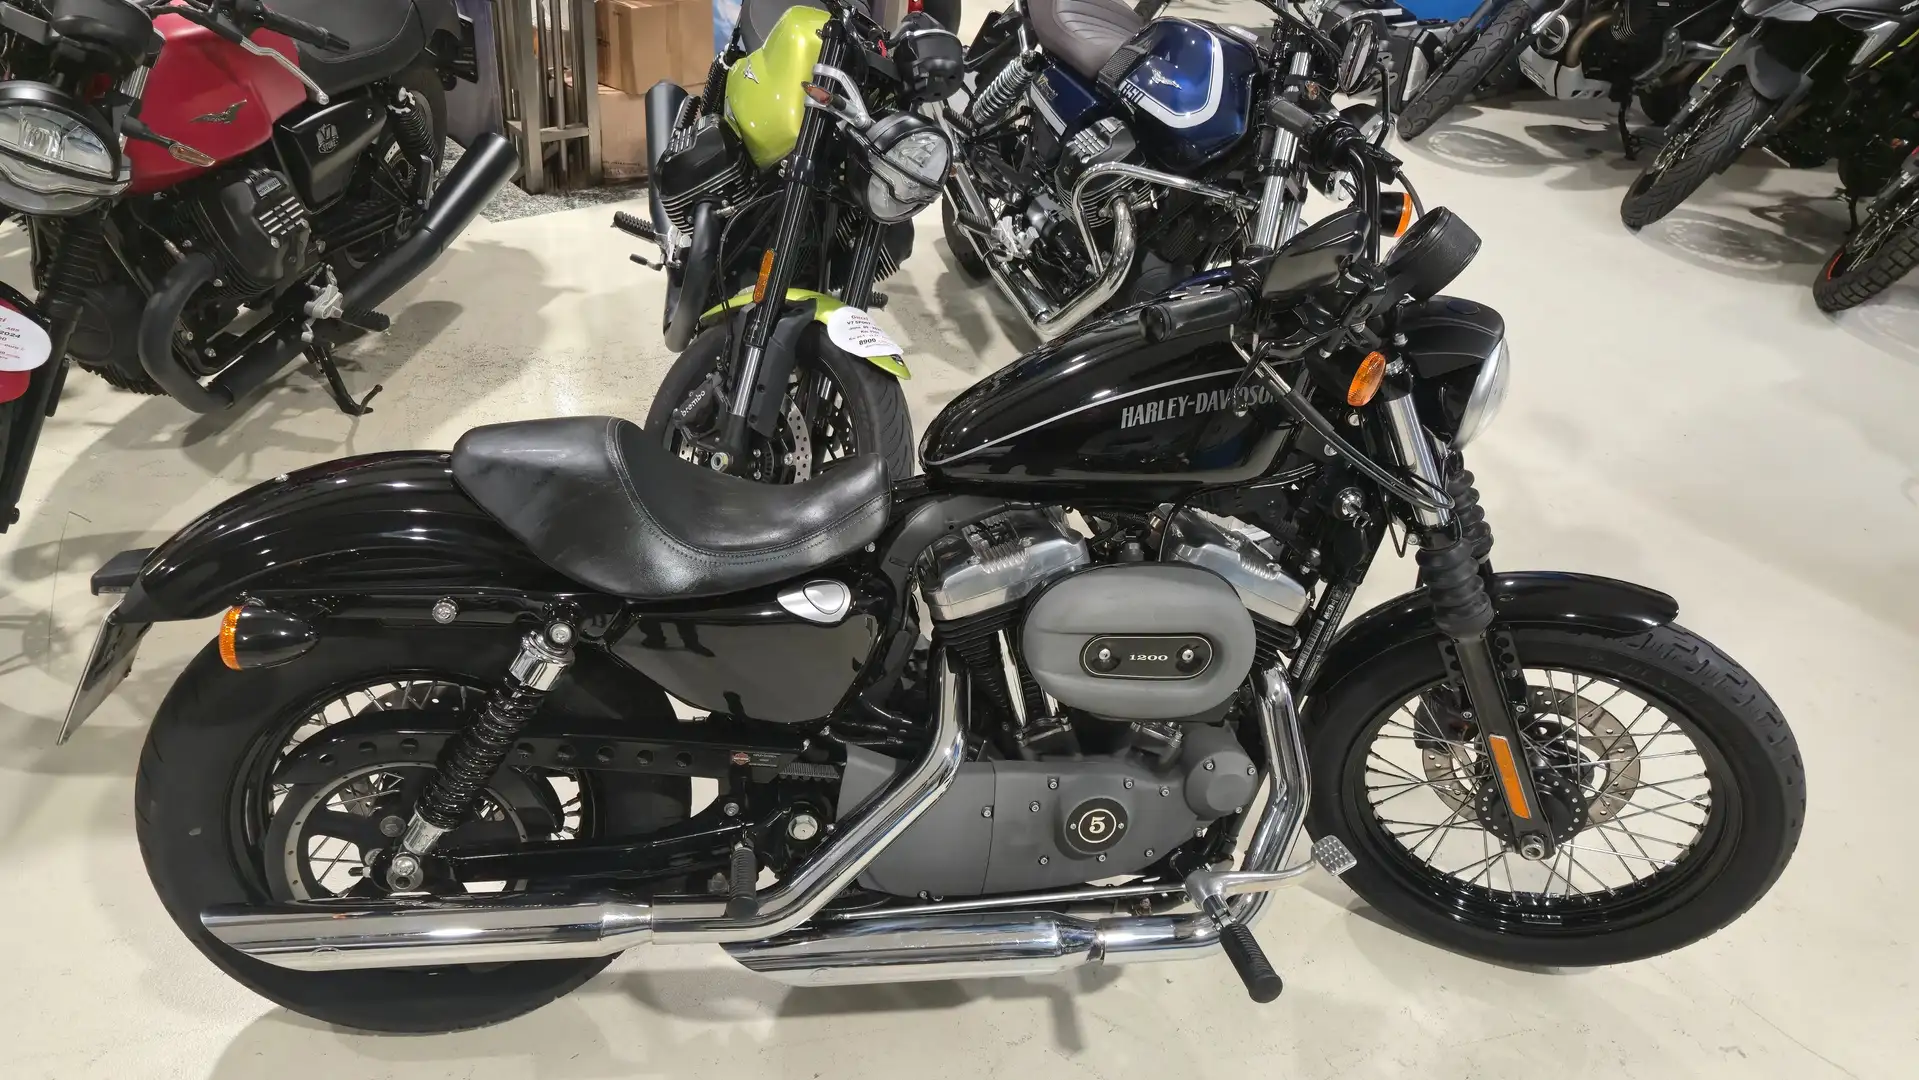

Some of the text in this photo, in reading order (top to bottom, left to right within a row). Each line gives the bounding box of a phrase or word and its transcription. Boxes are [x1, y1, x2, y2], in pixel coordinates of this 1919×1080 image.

[680, 390, 706, 417] brembo
[1121, 385, 1275, 429] HARLEY-DAVDSO
[1089, 816, 1105, 834] 5
